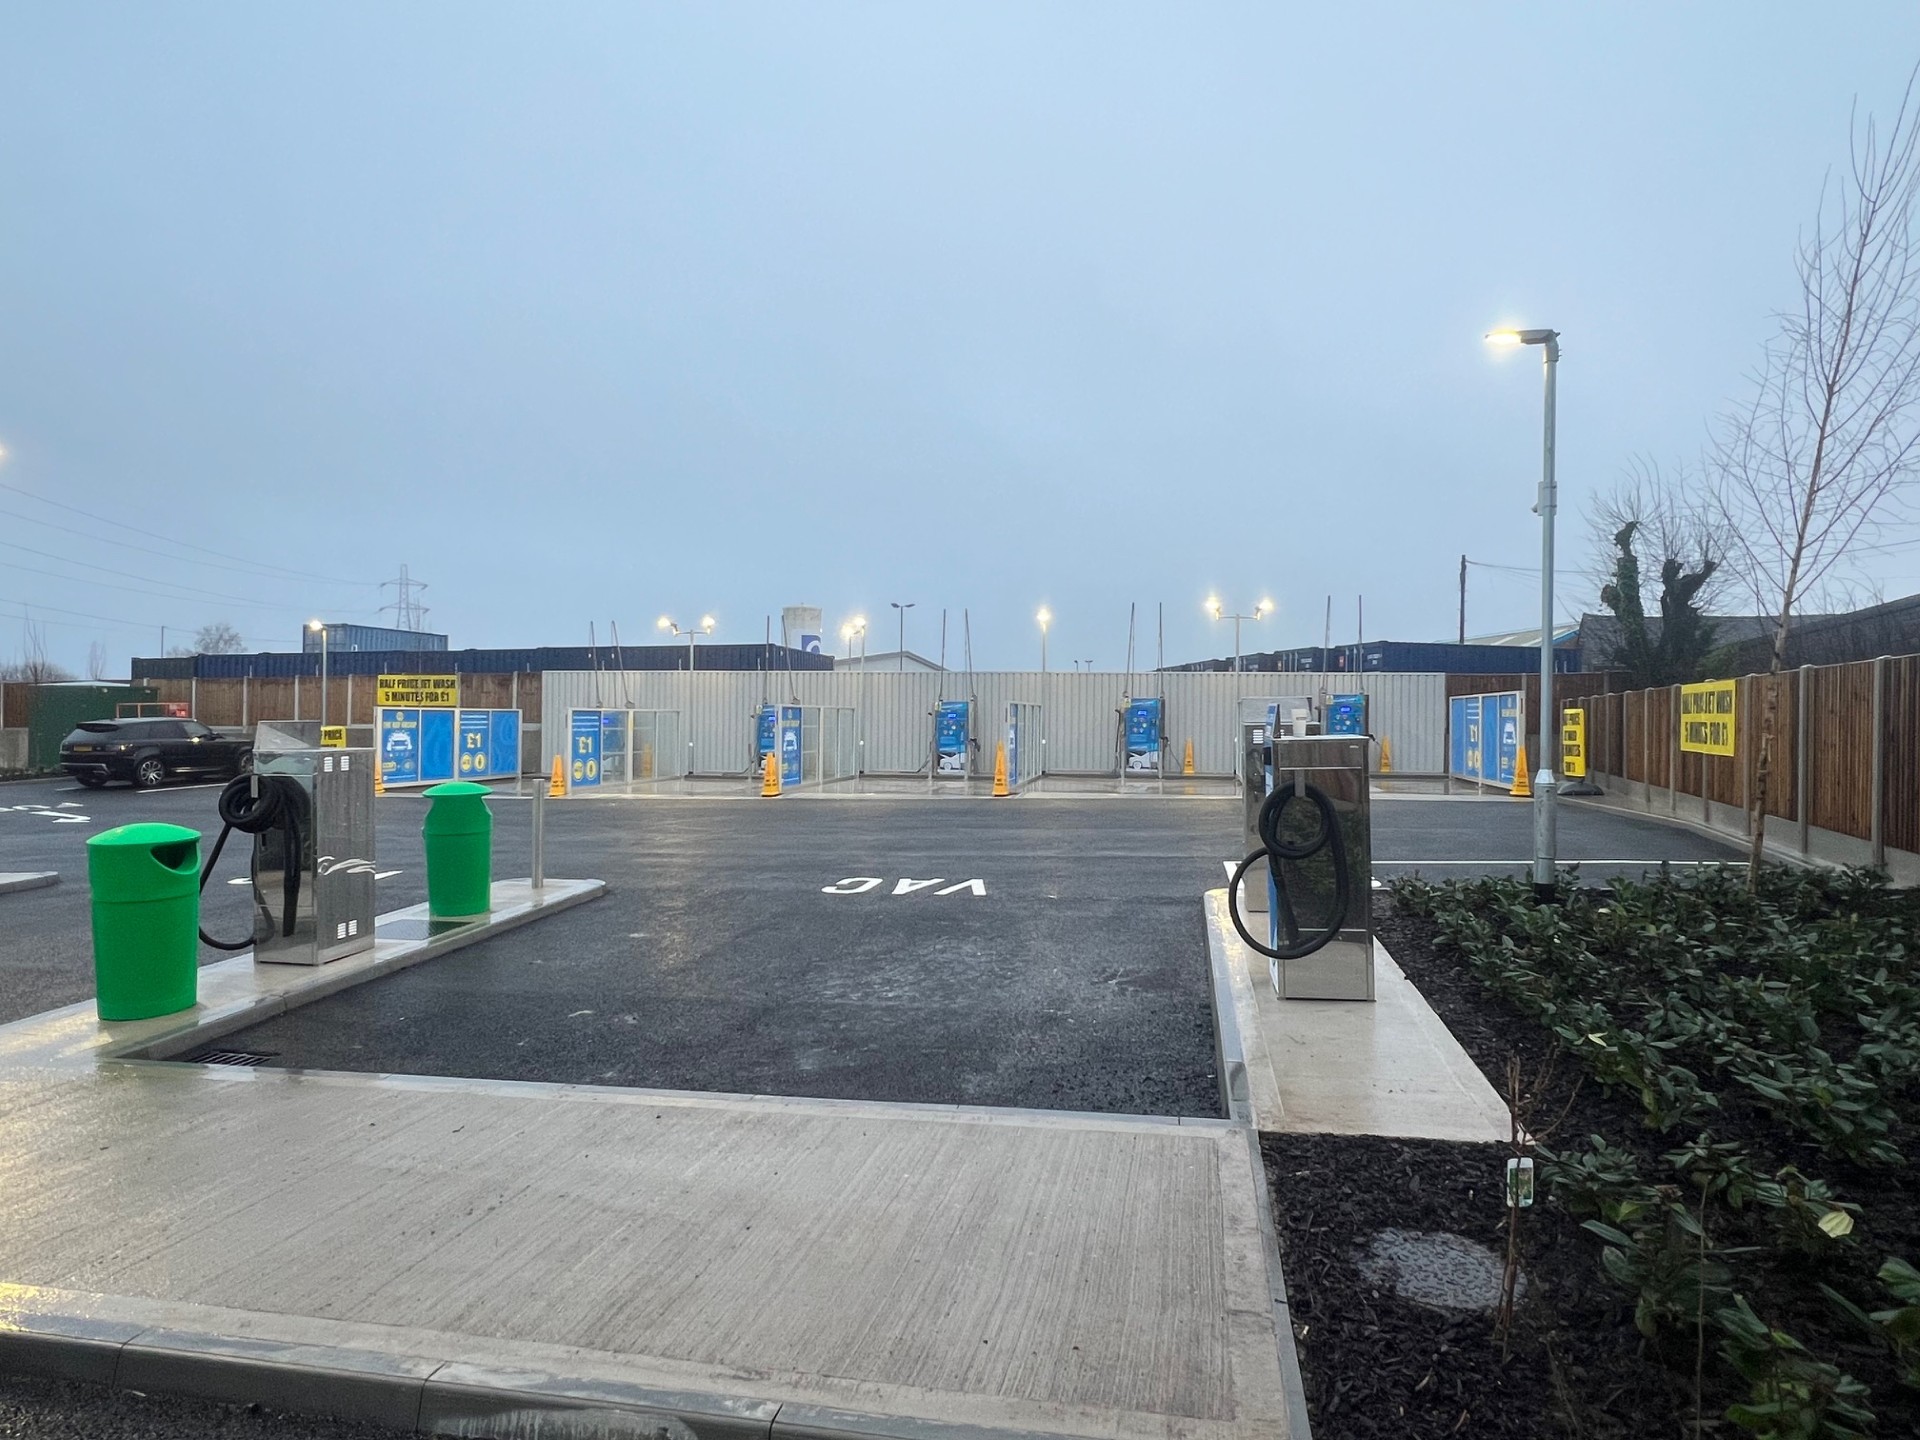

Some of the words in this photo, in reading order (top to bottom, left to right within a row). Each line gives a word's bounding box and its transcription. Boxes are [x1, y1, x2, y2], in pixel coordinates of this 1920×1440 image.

[380, 679, 396, 688] HALF
[398, 679, 419, 688] PRICE
[433, 679, 456, 688] WASH
[385, 692, 391, 701] 5
[392, 692, 424, 701] MINUTES
[425, 692, 439, 701] FOR
[441, 692, 450, 701] £1
[466, 732, 481, 748] £1
[579, 736, 593, 753] £1
[821, 877, 987, 895] VAC
